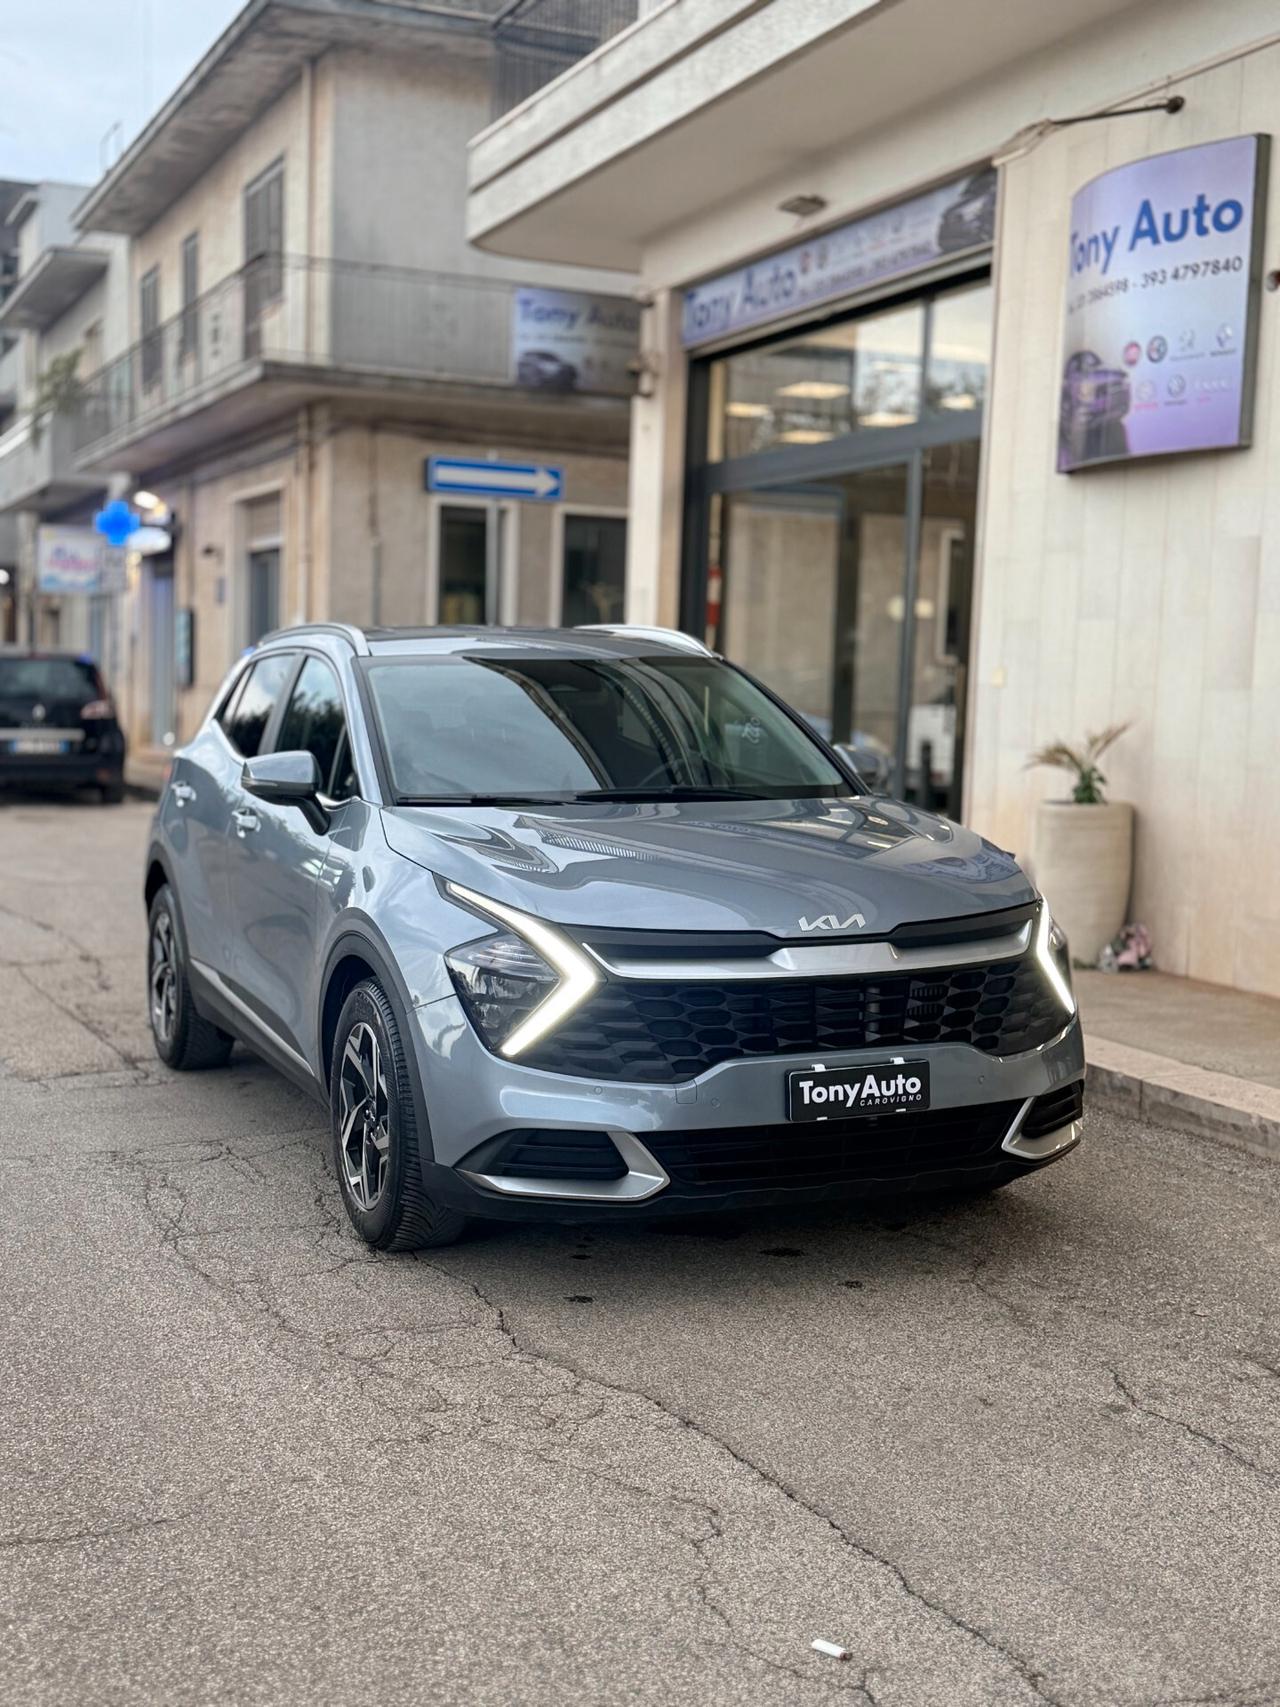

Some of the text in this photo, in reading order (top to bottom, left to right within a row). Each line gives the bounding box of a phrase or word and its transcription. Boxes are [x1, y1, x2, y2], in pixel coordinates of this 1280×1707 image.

[1128, 194, 1243, 251] Auto
[1171, 255, 1243, 281] 4797840
[519, 297, 575, 330] Tony
[685, 288, 736, 329] Tony
[743, 265, 797, 306] Auto
[798, 913, 866, 931] KIA
[799, 1074, 922, 1108] TonyAuto
[860, 1094, 922, 1107] CAROVIGNO
